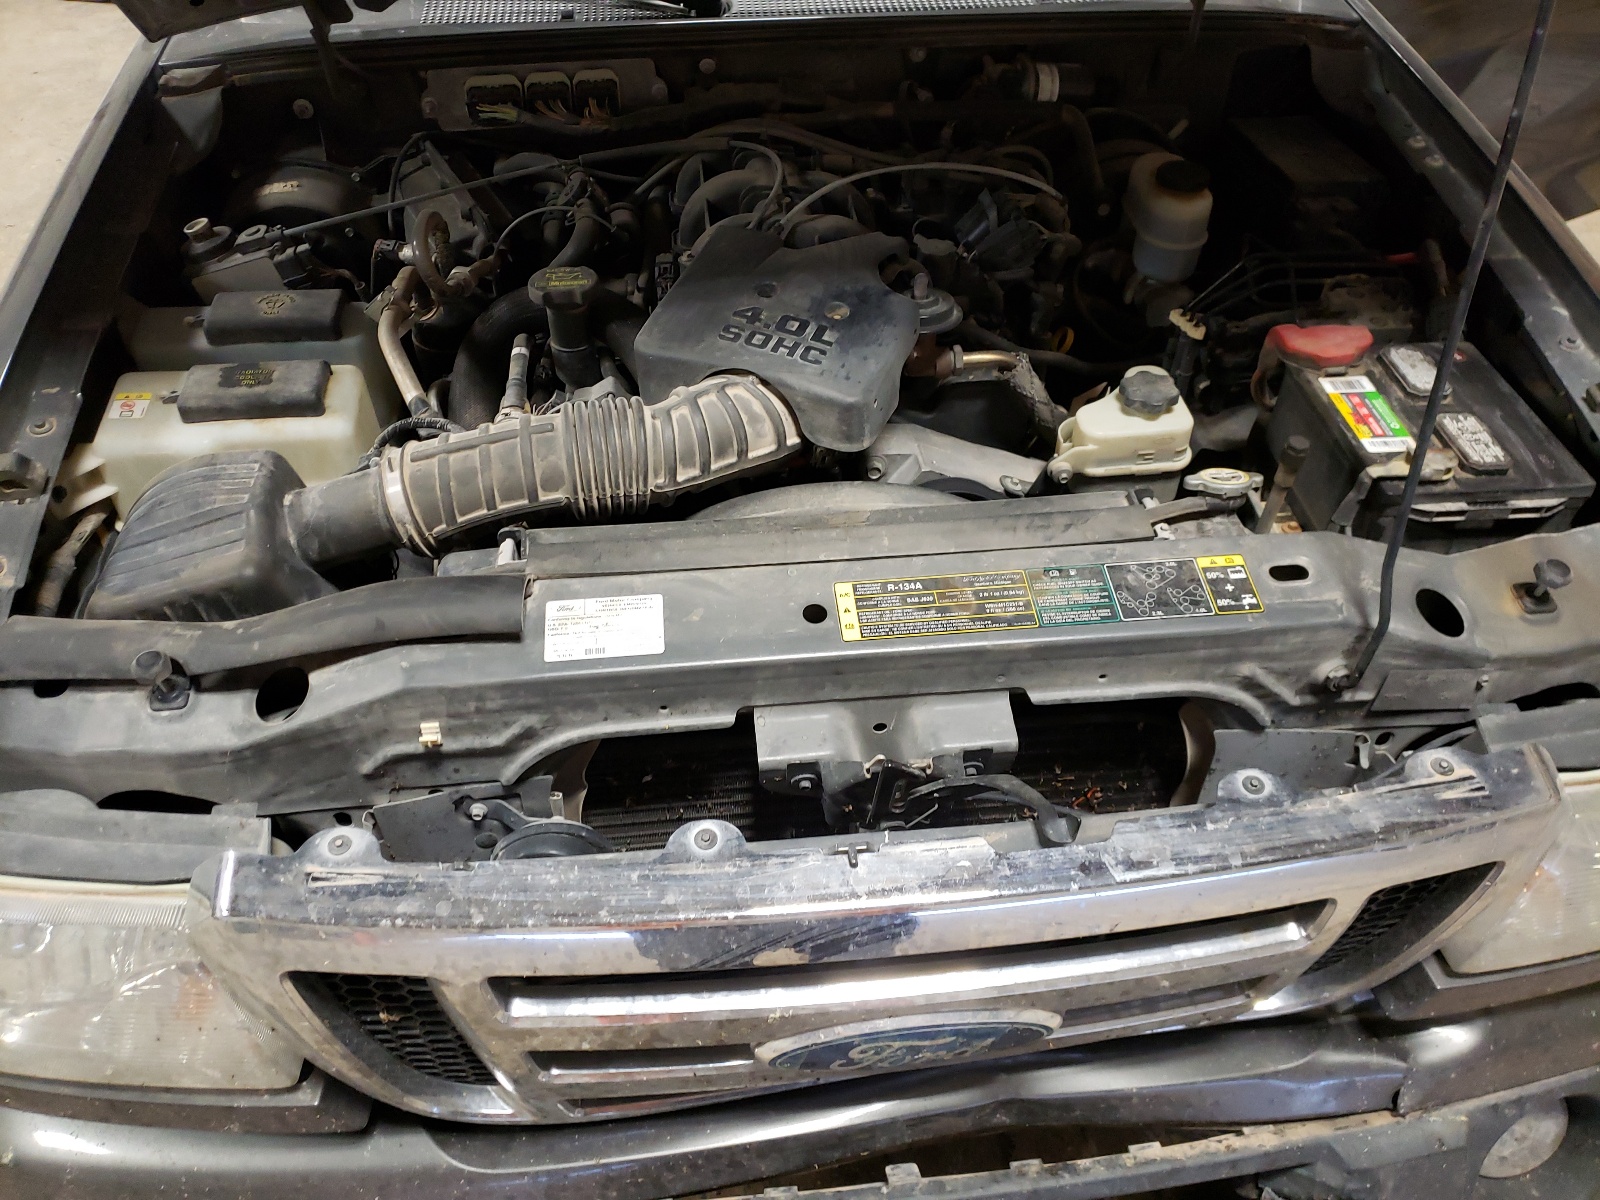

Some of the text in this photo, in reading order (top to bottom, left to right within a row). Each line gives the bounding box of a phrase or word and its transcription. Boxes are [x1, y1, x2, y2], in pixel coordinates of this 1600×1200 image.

[732, 306, 834, 348] 4.0L
[718, 323, 828, 366] SOHC
[1206, 571, 1225, 579] 50%
[887, 582, 923, 592] R-134A
[1216, 598, 1235, 606] 50%
[829, 1035, 997, 1071] Ford
